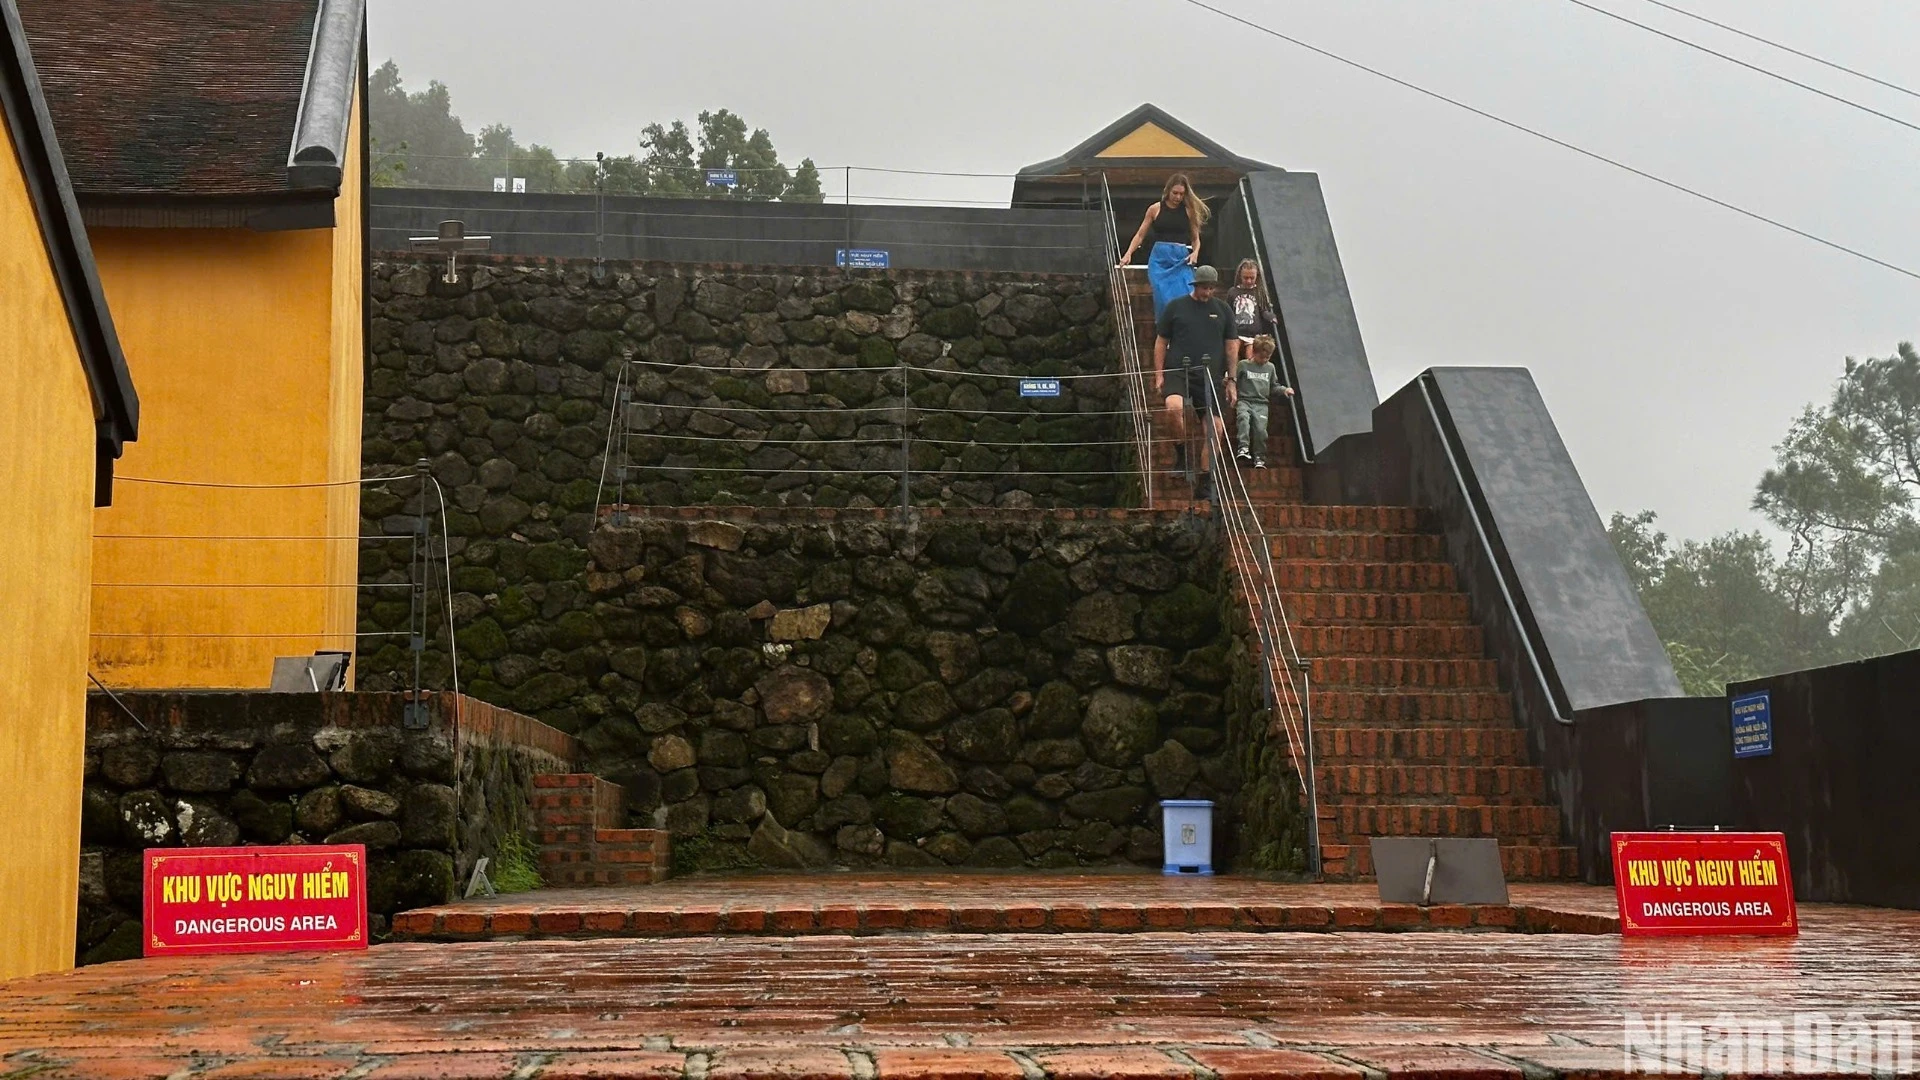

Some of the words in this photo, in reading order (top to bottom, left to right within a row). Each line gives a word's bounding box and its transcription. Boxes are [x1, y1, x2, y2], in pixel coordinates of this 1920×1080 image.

[163, 875, 200, 904] KHU
[206, 872, 242, 908] VỰC
[248, 873, 297, 901] NGUY
[302, 861, 349, 899] HIỂM
[1628, 859, 1659, 887] KHU
[1661, 857, 1692, 892] VỰC
[1695, 859, 1735, 887] NGUY
[1738, 849, 1778, 887] HIỂM
[175, 916, 286, 935] DANGEROUS
[289, 915, 338, 931] AREA
[1642, 902, 1731, 917] DANGEROUS
[1735, 902, 1773, 916] AREA
